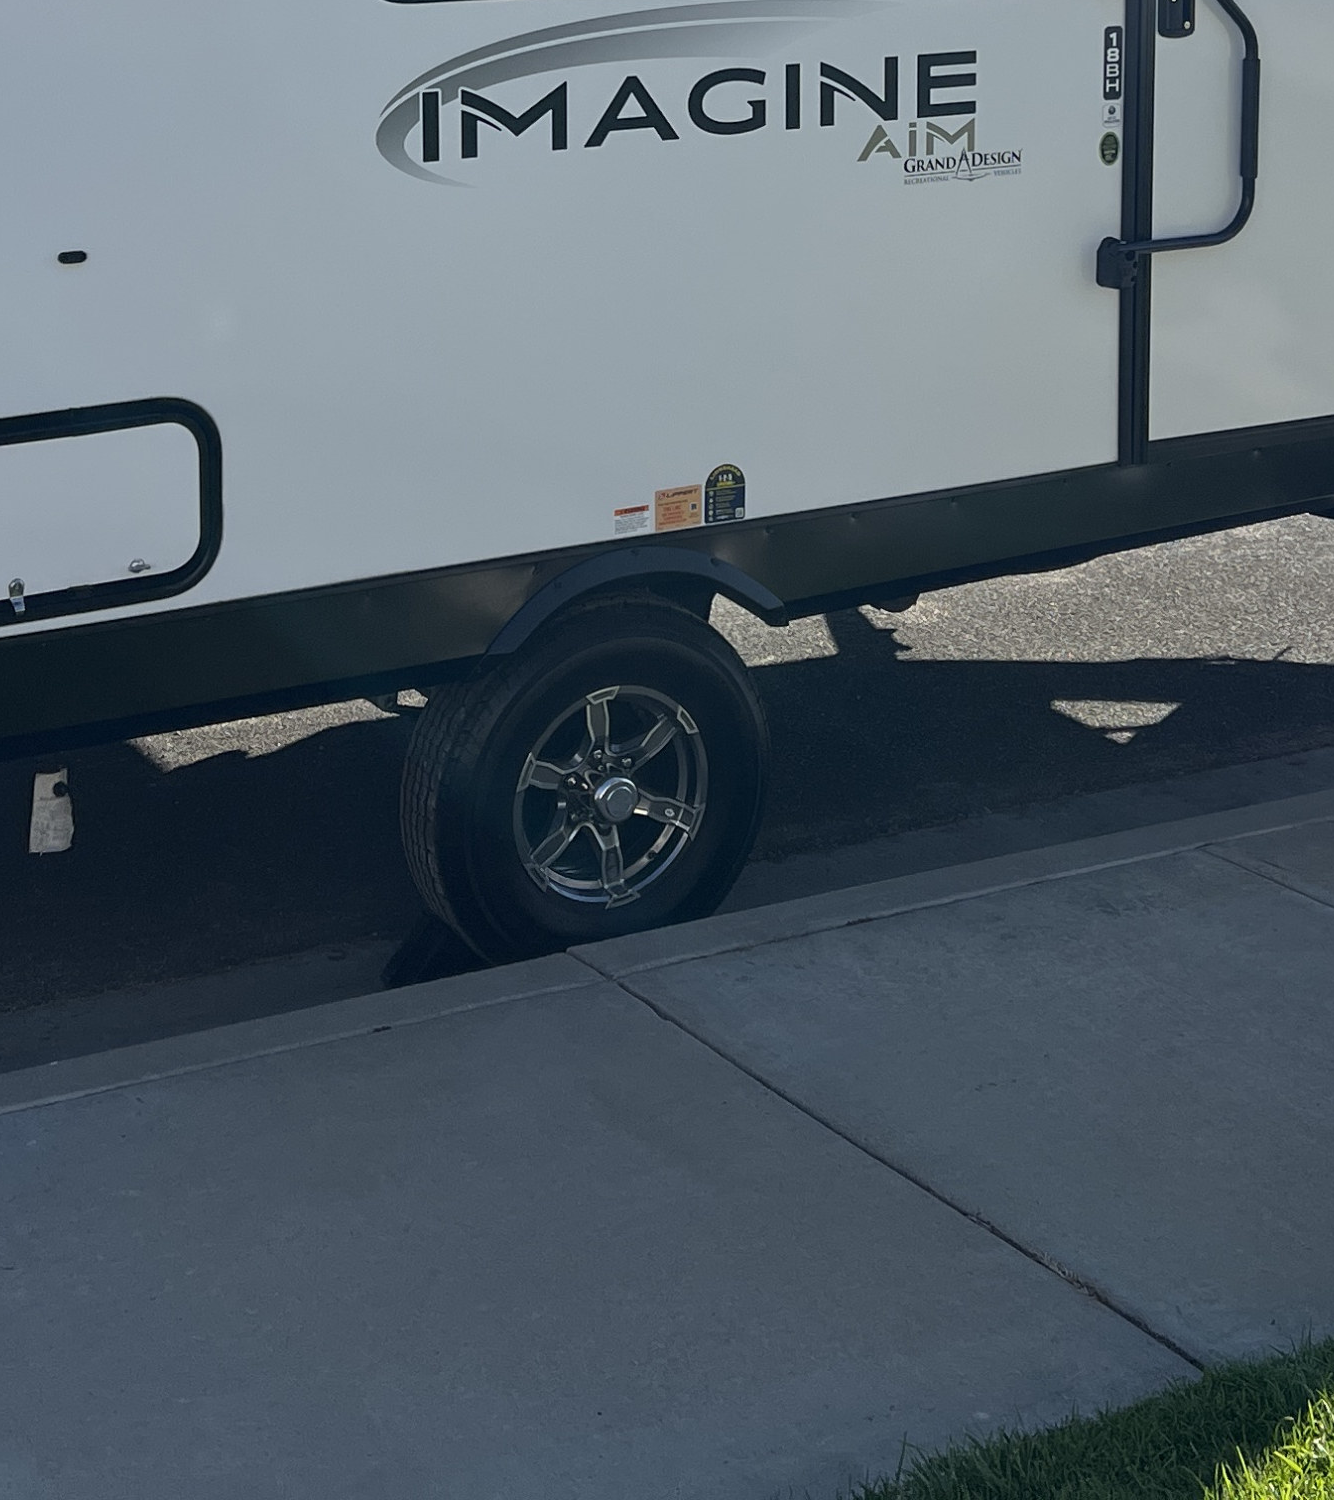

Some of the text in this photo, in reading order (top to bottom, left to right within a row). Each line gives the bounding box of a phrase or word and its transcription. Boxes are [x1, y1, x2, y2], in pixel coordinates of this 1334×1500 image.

[1105, 31, 1120, 93] 18BH
[422, 50, 977, 163] IMAGINE
[903, 150, 1022, 174] GRAND DESIGN
